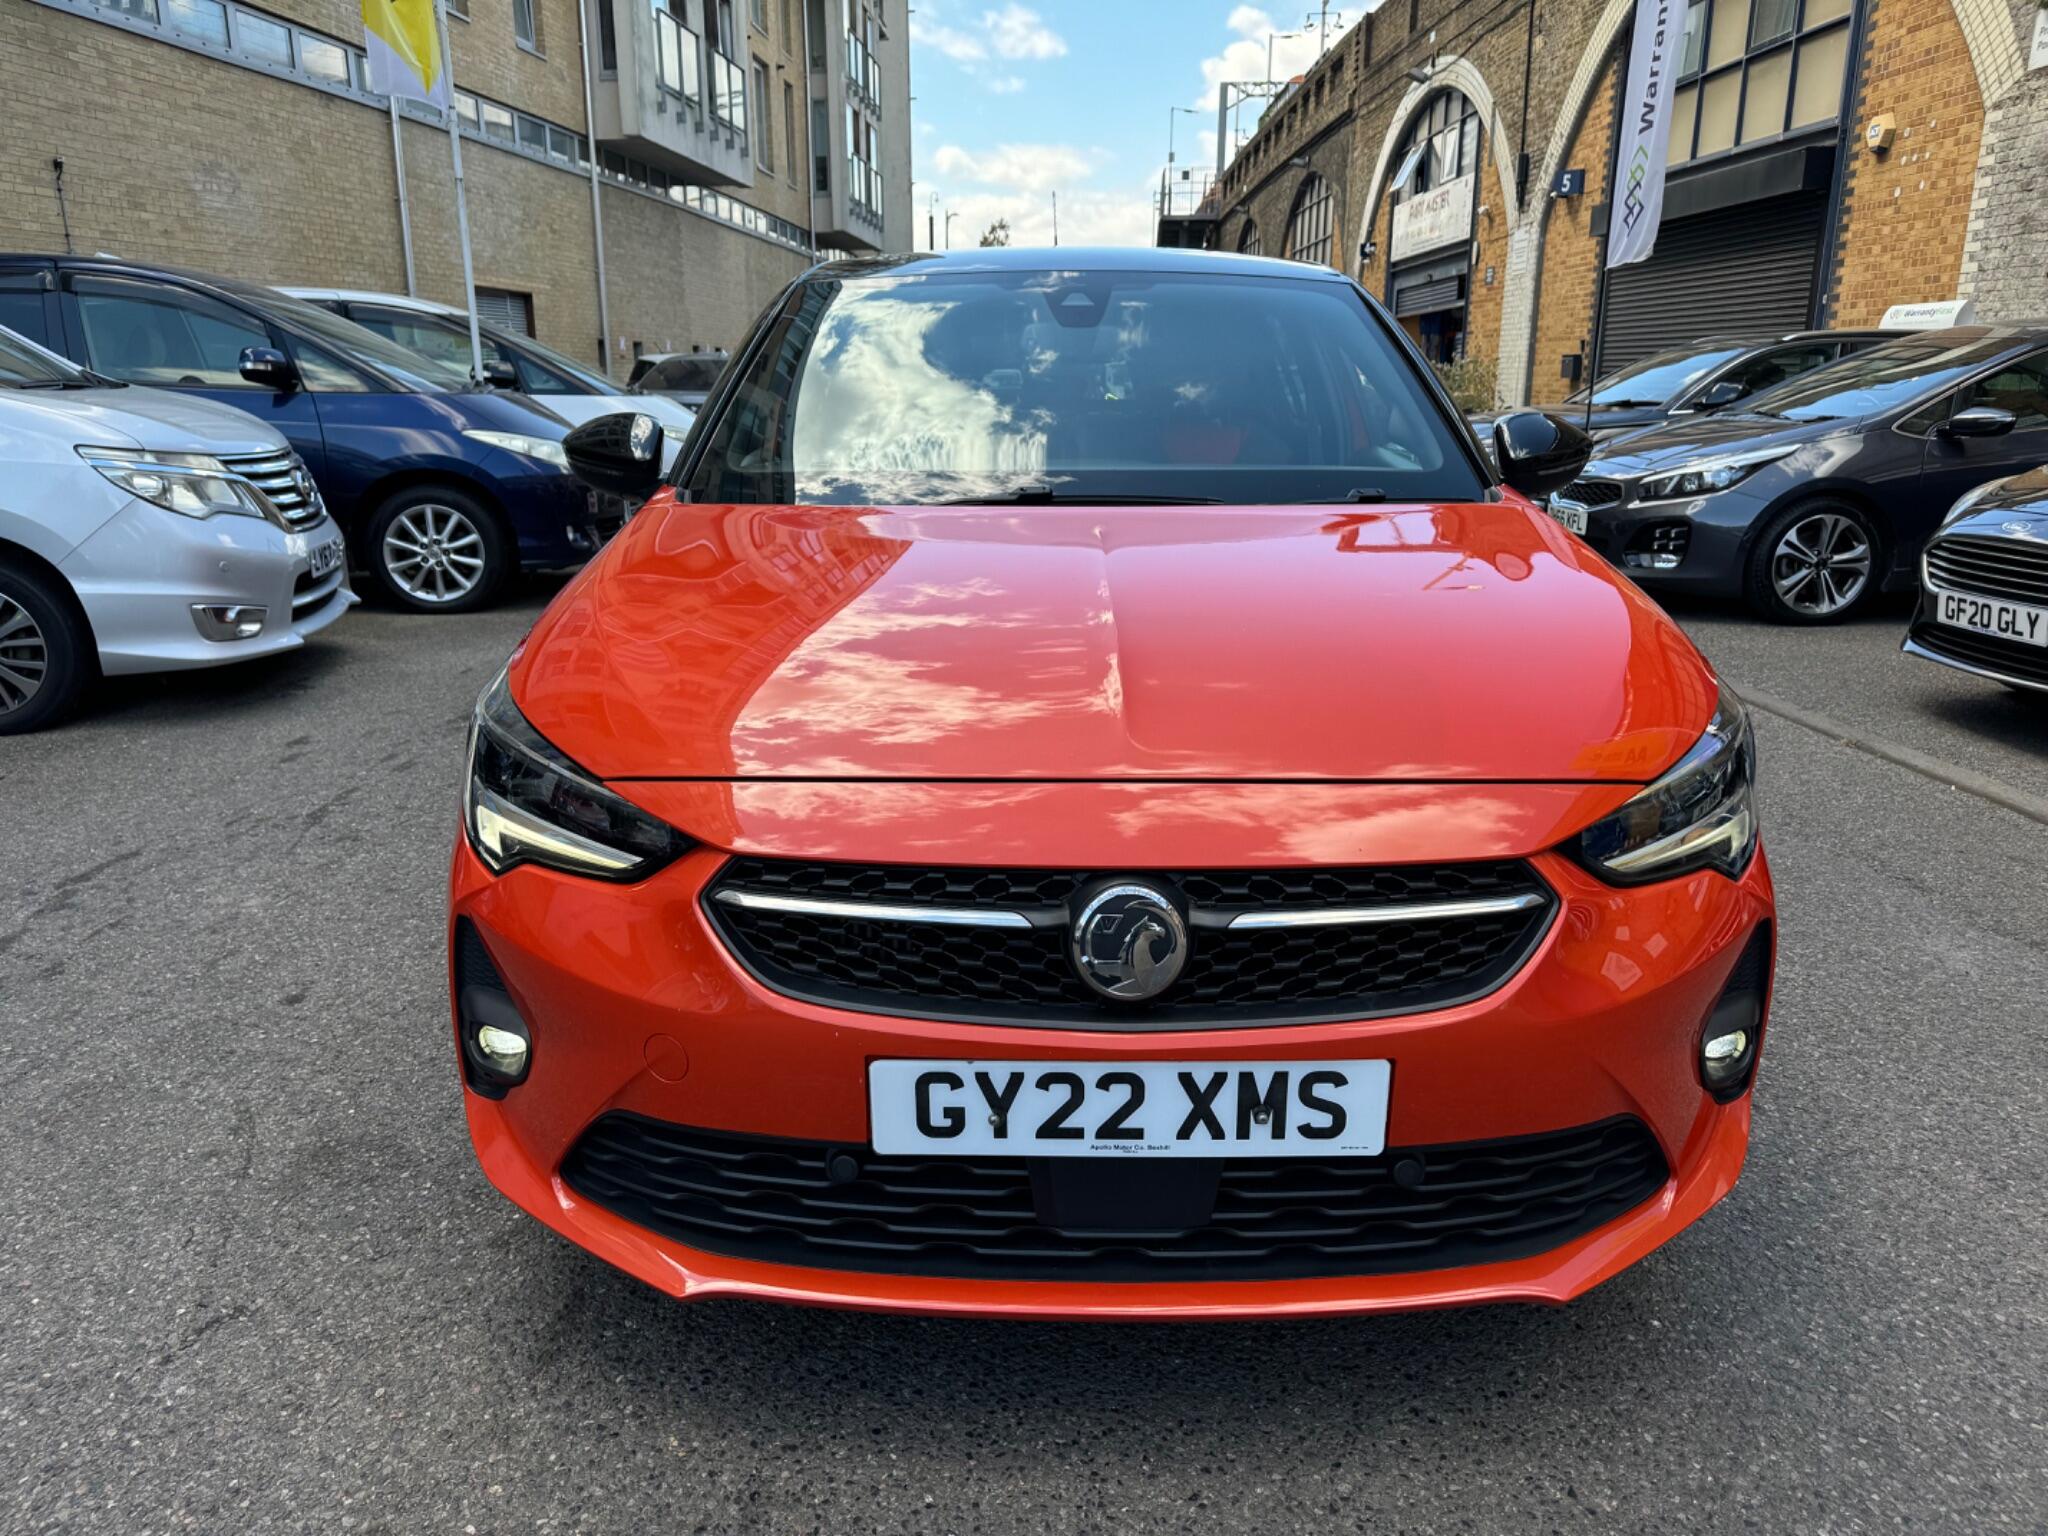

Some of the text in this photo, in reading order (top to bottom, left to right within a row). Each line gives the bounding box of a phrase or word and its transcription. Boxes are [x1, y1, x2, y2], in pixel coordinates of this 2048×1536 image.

[1638, 0, 1668, 136] Warran
[1561, 173, 1571, 193] 5
[1567, 511, 1582, 531] KFL
[1945, 595, 2040, 639] GF20 GLY
[914, 1070, 1350, 1140] GY22 XMS
